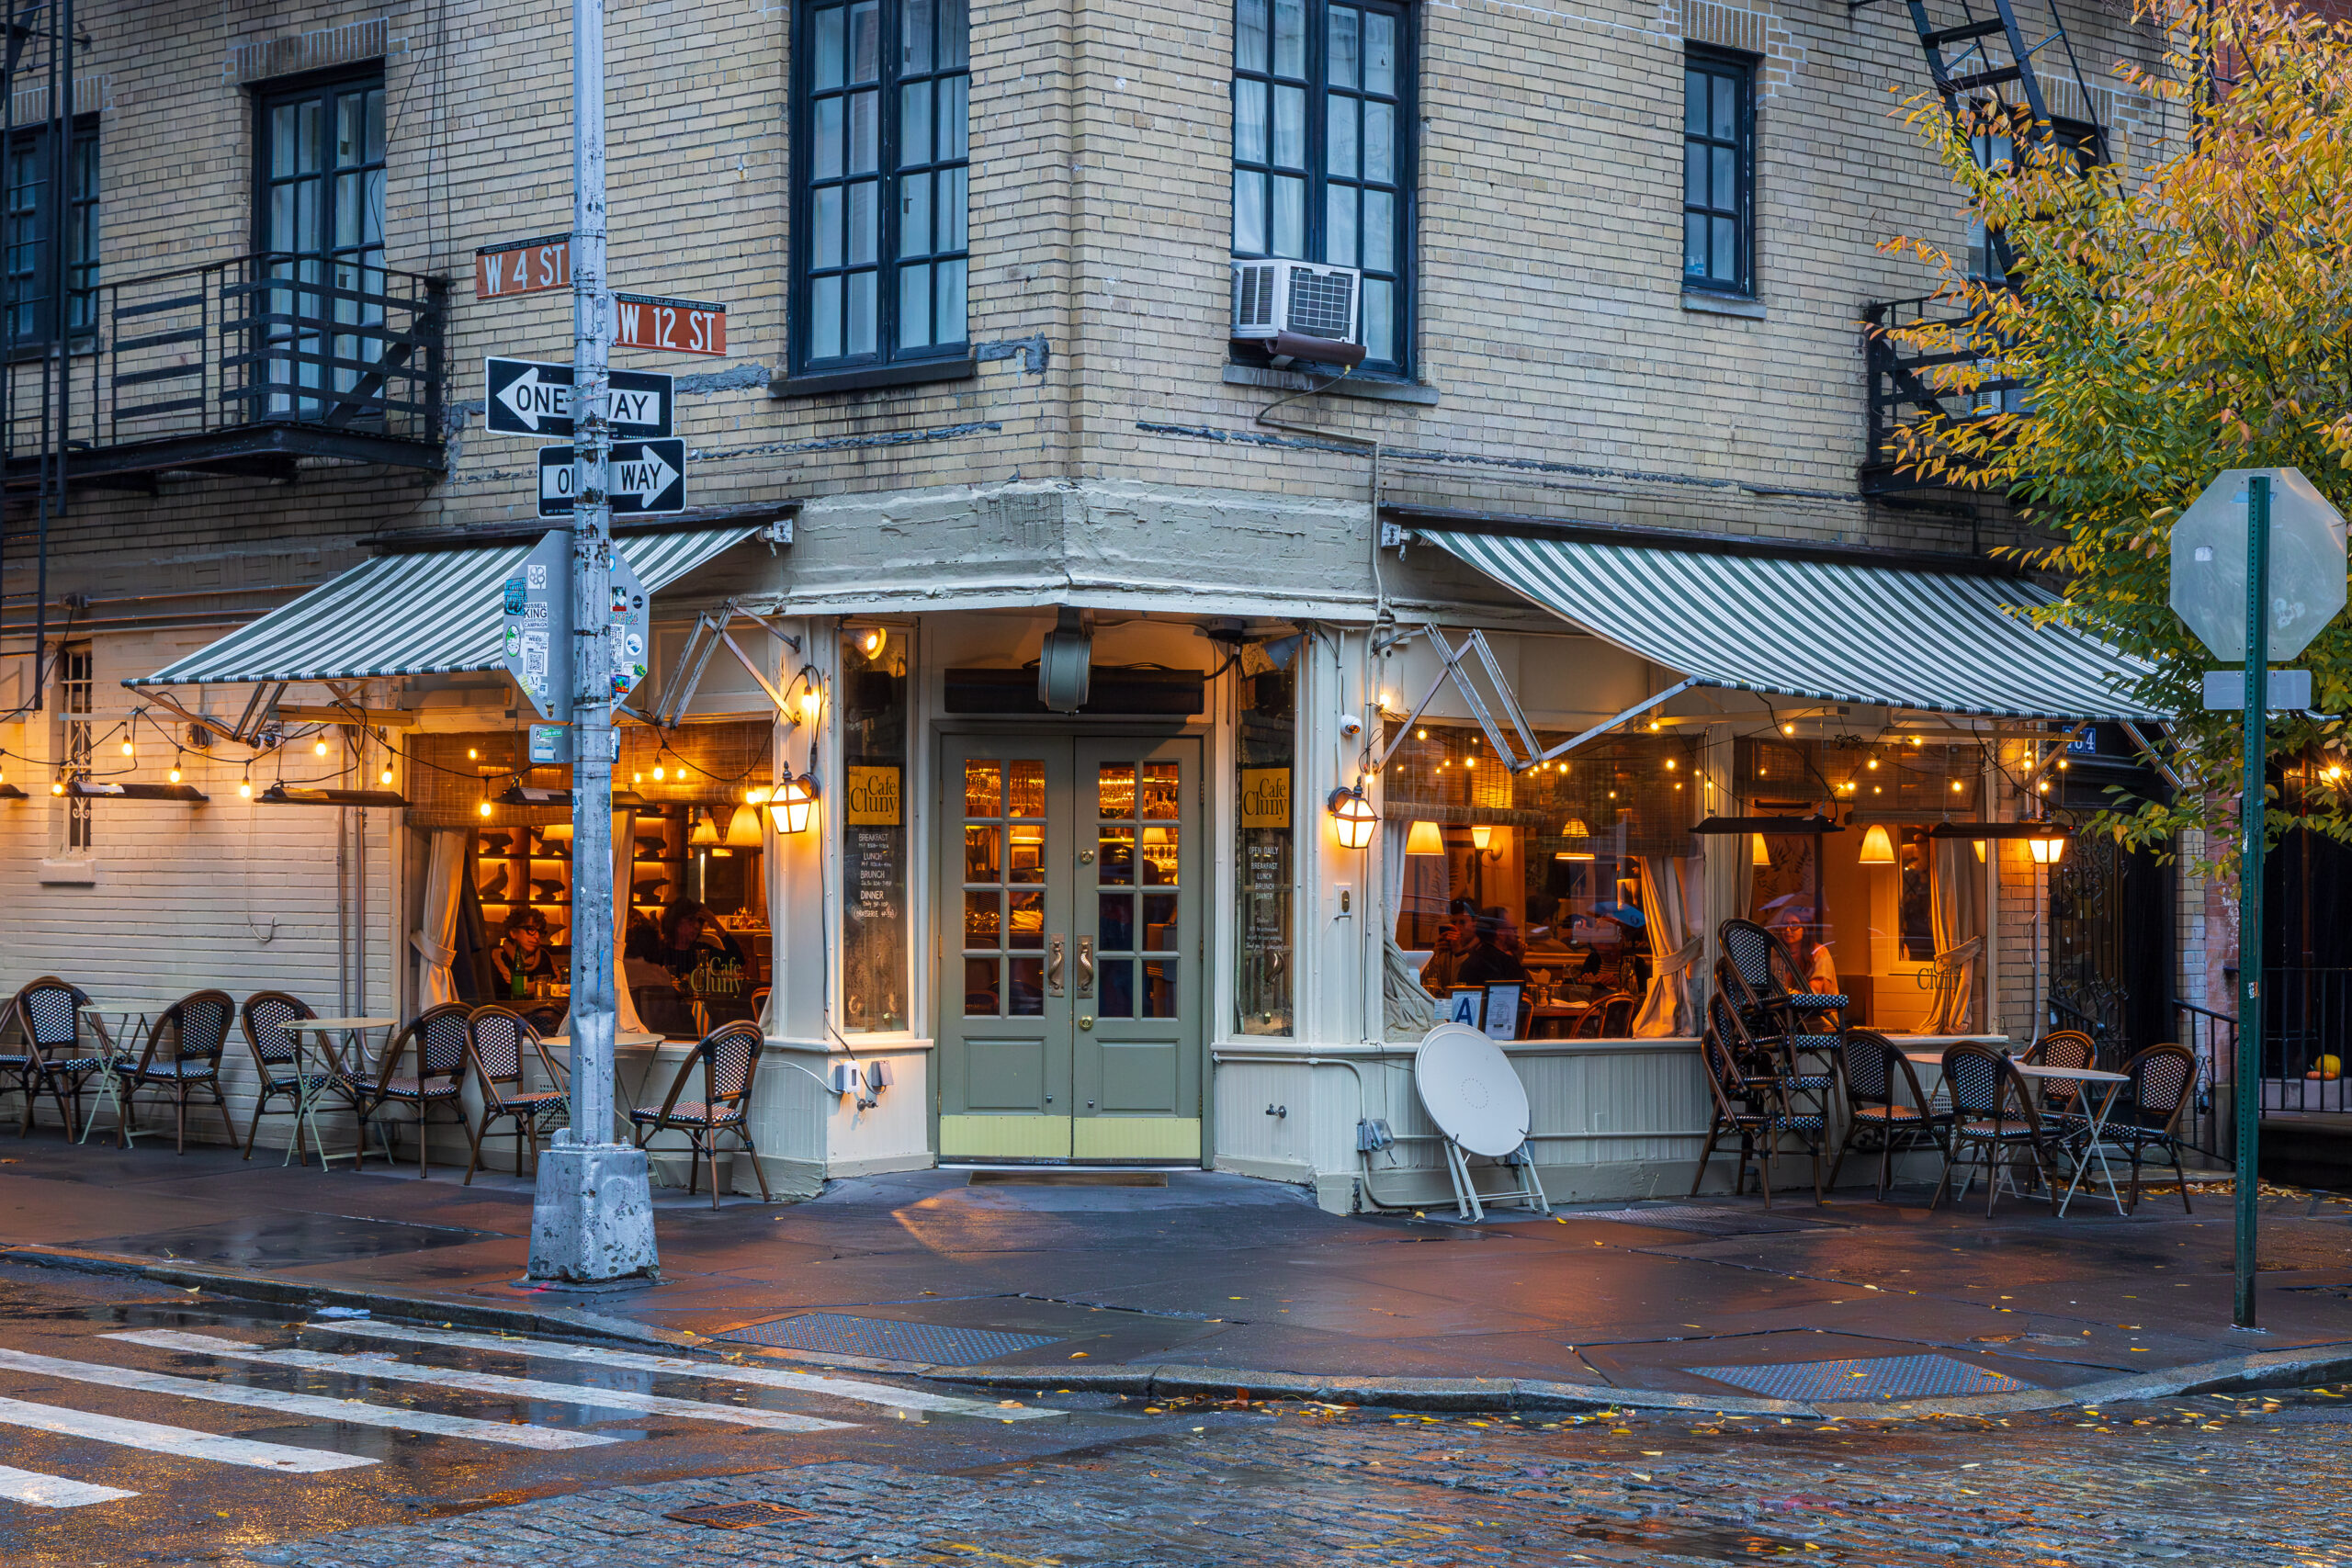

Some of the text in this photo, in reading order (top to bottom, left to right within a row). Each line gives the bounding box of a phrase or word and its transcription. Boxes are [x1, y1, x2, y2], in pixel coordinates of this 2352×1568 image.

[484, 244, 565, 295] W 4 ST
[620, 294, 721, 311] GREENWICH VILLAGE HISTORIC DISTRICT
[620, 303, 716, 352] W 12 ST
[516, 384, 568, 415] ONE
[621, 462, 663, 492] WAY
[524, 608, 548, 618] KING
[867, 775, 896, 796] Cafe
[1260, 777, 1286, 798] Cafe
[850, 786, 898, 818] Cluny
[1243, 790, 1287, 820] Cluny
[858, 833, 888, 842] BREAKFAST
[863, 852, 883, 861] LUNCH
[1249, 846, 1279, 855] OPEN DAILY
[860, 870, 886, 879] BRUNCH
[1250, 862, 1278, 870] BREAKFAST
[860, 890, 885, 900] DINNER
[1255, 882, 1275, 890] BRUNCH
[1256, 892, 1273, 900] DINNER
[709, 956, 741, 976] Cafe
[690, 968, 744, 998] Cluny
[1454, 997, 1474, 1028] A
